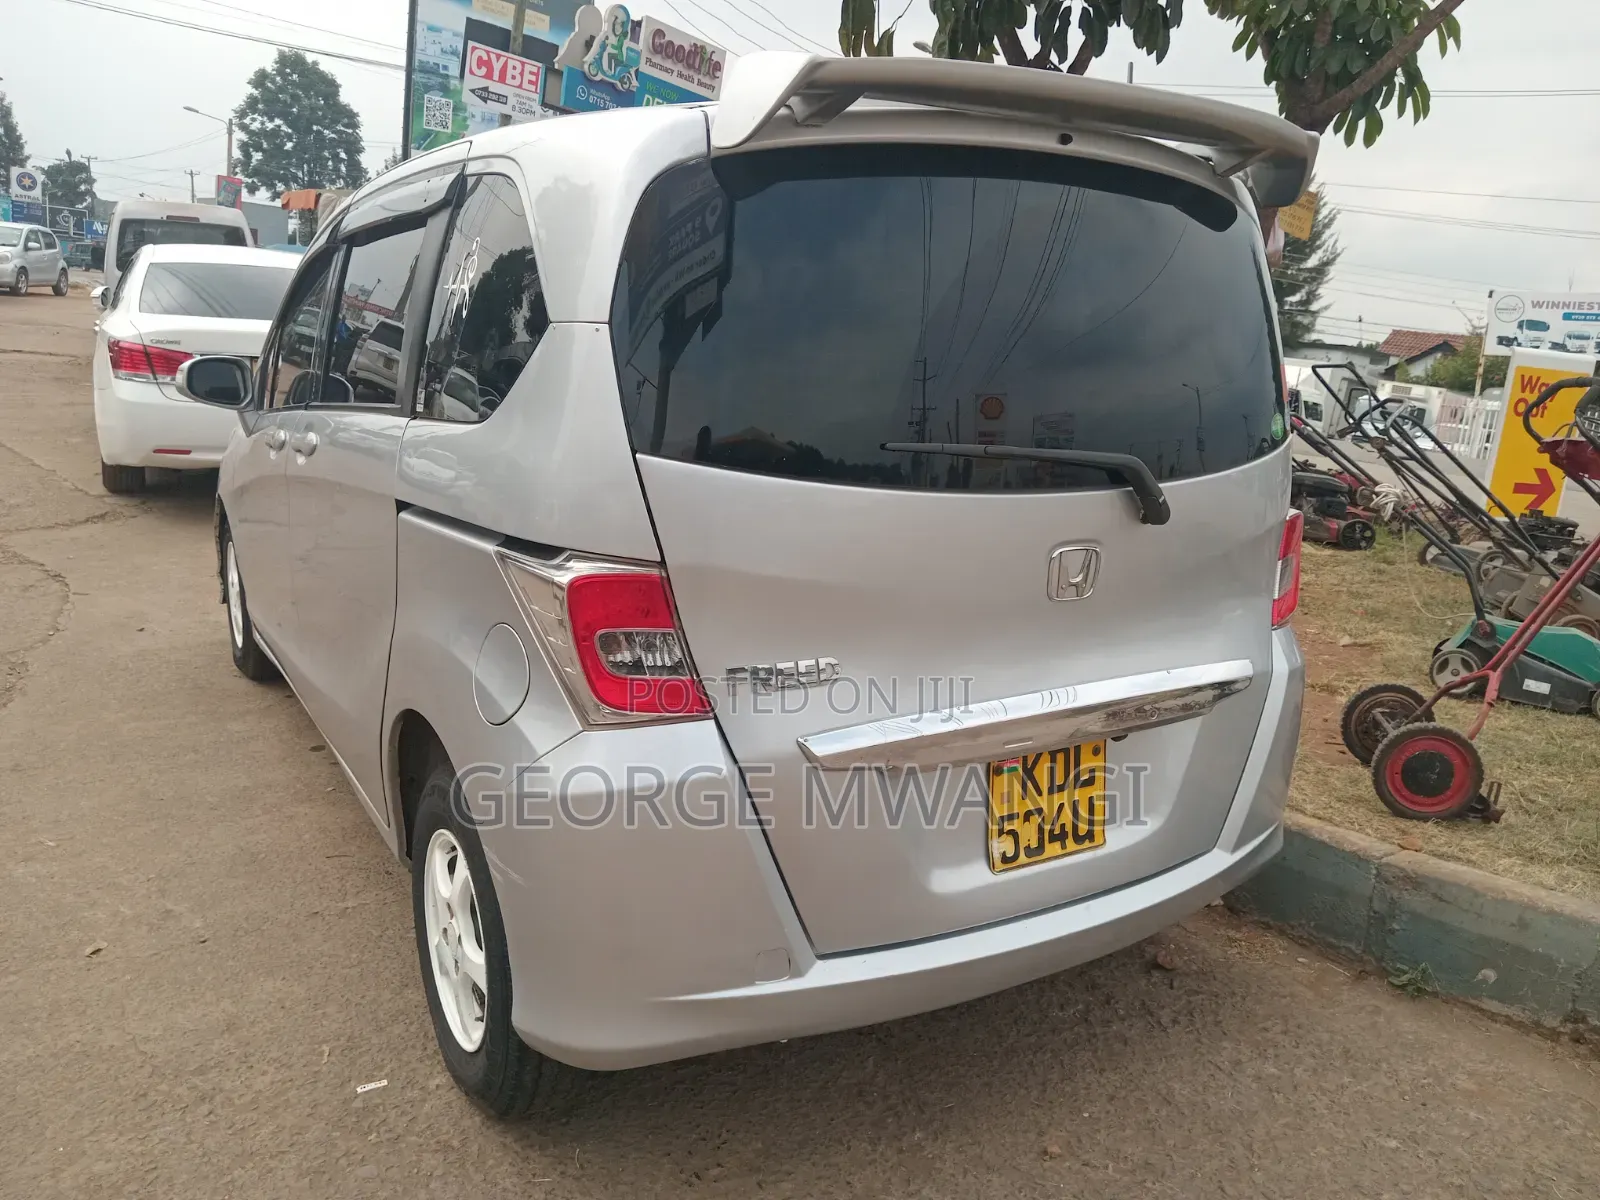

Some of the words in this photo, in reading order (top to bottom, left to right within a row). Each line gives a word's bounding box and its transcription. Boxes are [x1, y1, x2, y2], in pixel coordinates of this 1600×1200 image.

[471, 48, 541, 94] CYBE
[651, 28, 722, 79] Goodlife
[645, 56, 675, 77] Pharmacy
[676, 69, 695, 85] Health
[696, 78, 716, 94] Beauty
[588, 94, 605, 108] 0715
[14, 193, 41, 201] ASTRAL
[726, 656, 841, 697] FREED
[1020, 744, 1096, 801] KDL
